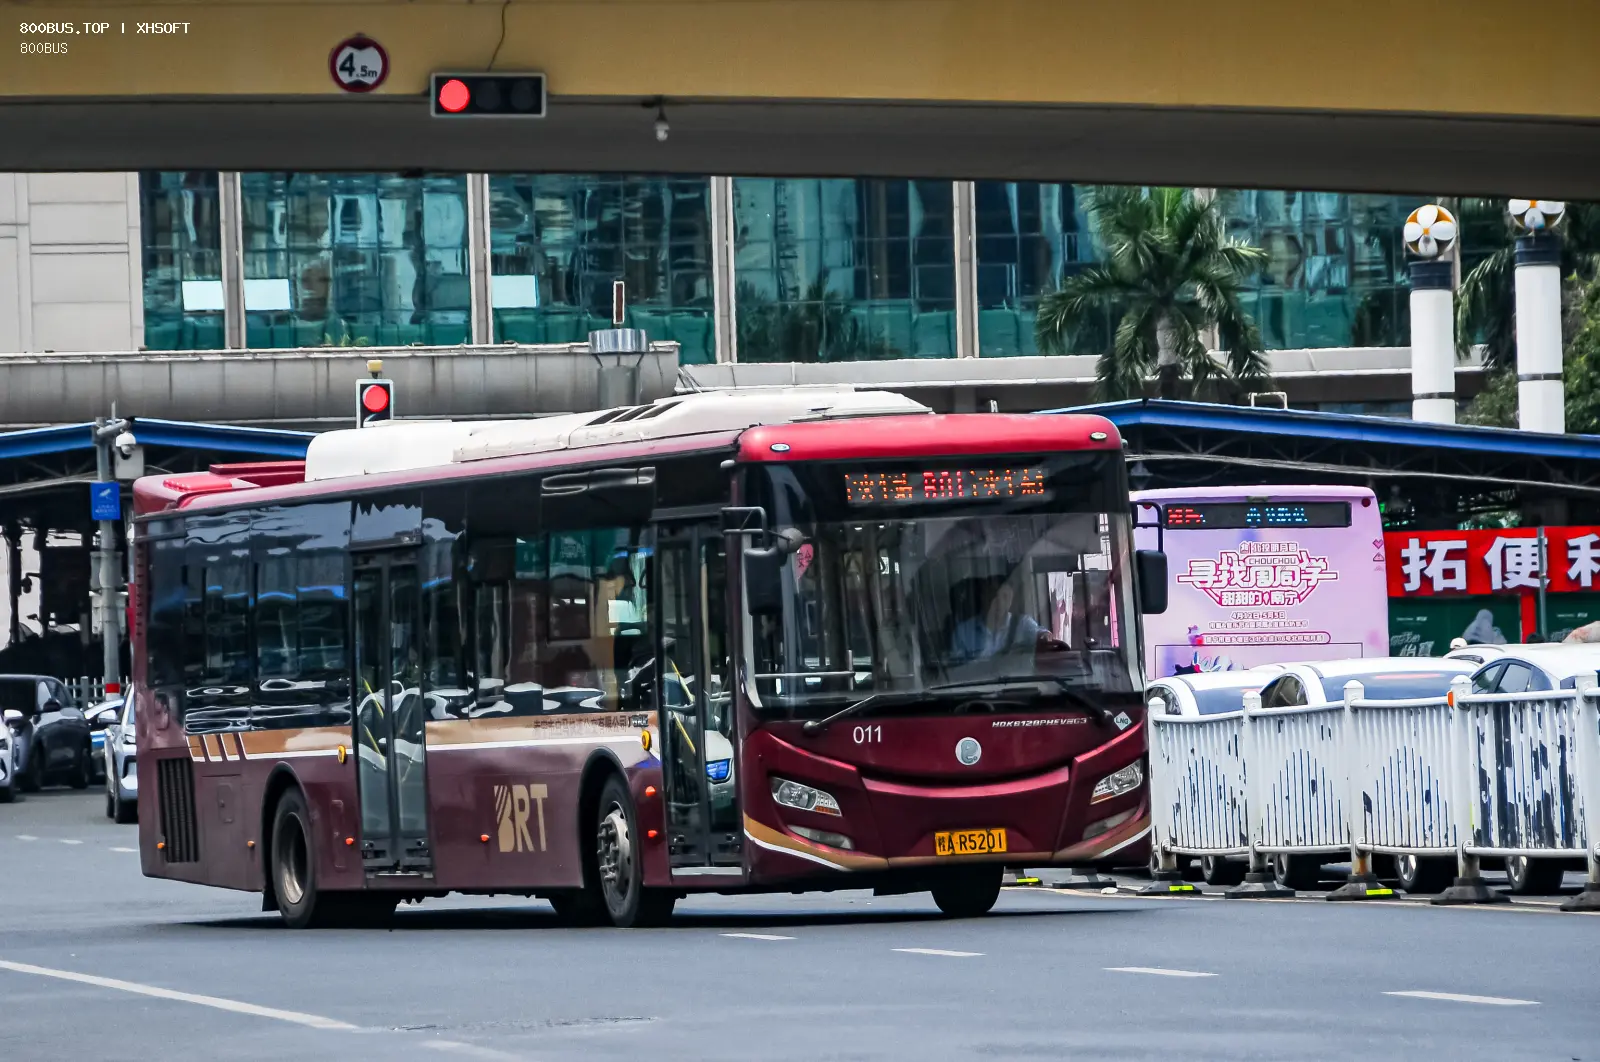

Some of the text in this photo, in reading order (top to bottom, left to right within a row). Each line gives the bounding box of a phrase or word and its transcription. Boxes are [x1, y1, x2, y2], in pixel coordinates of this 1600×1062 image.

[1248, 557, 1297, 565] CHOUCHOU
[853, 725, 881, 744] 011
[493, 783, 548, 853] BRT
